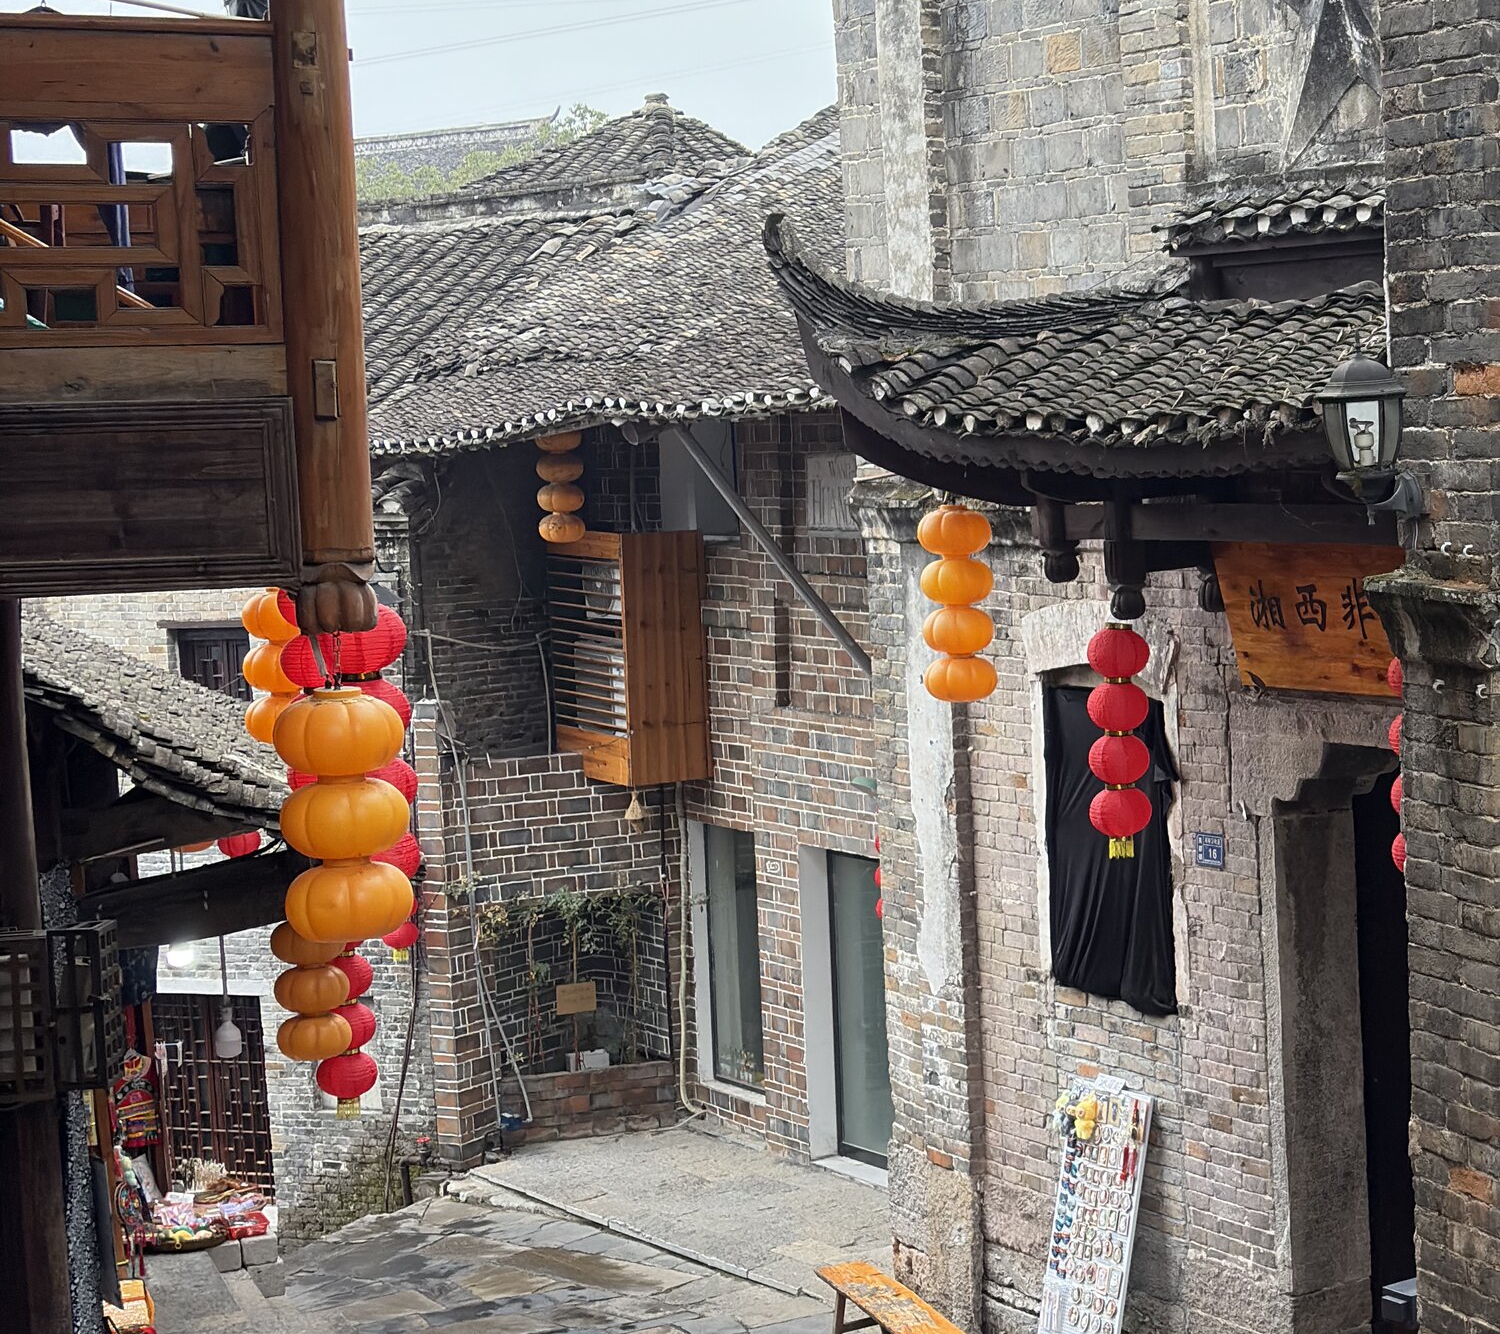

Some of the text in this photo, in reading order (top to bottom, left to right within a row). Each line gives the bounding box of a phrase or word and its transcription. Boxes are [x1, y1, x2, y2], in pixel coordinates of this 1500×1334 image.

[1249, 578, 1376, 640] 湘西非
[1208, 848, 1217, 859] 16
